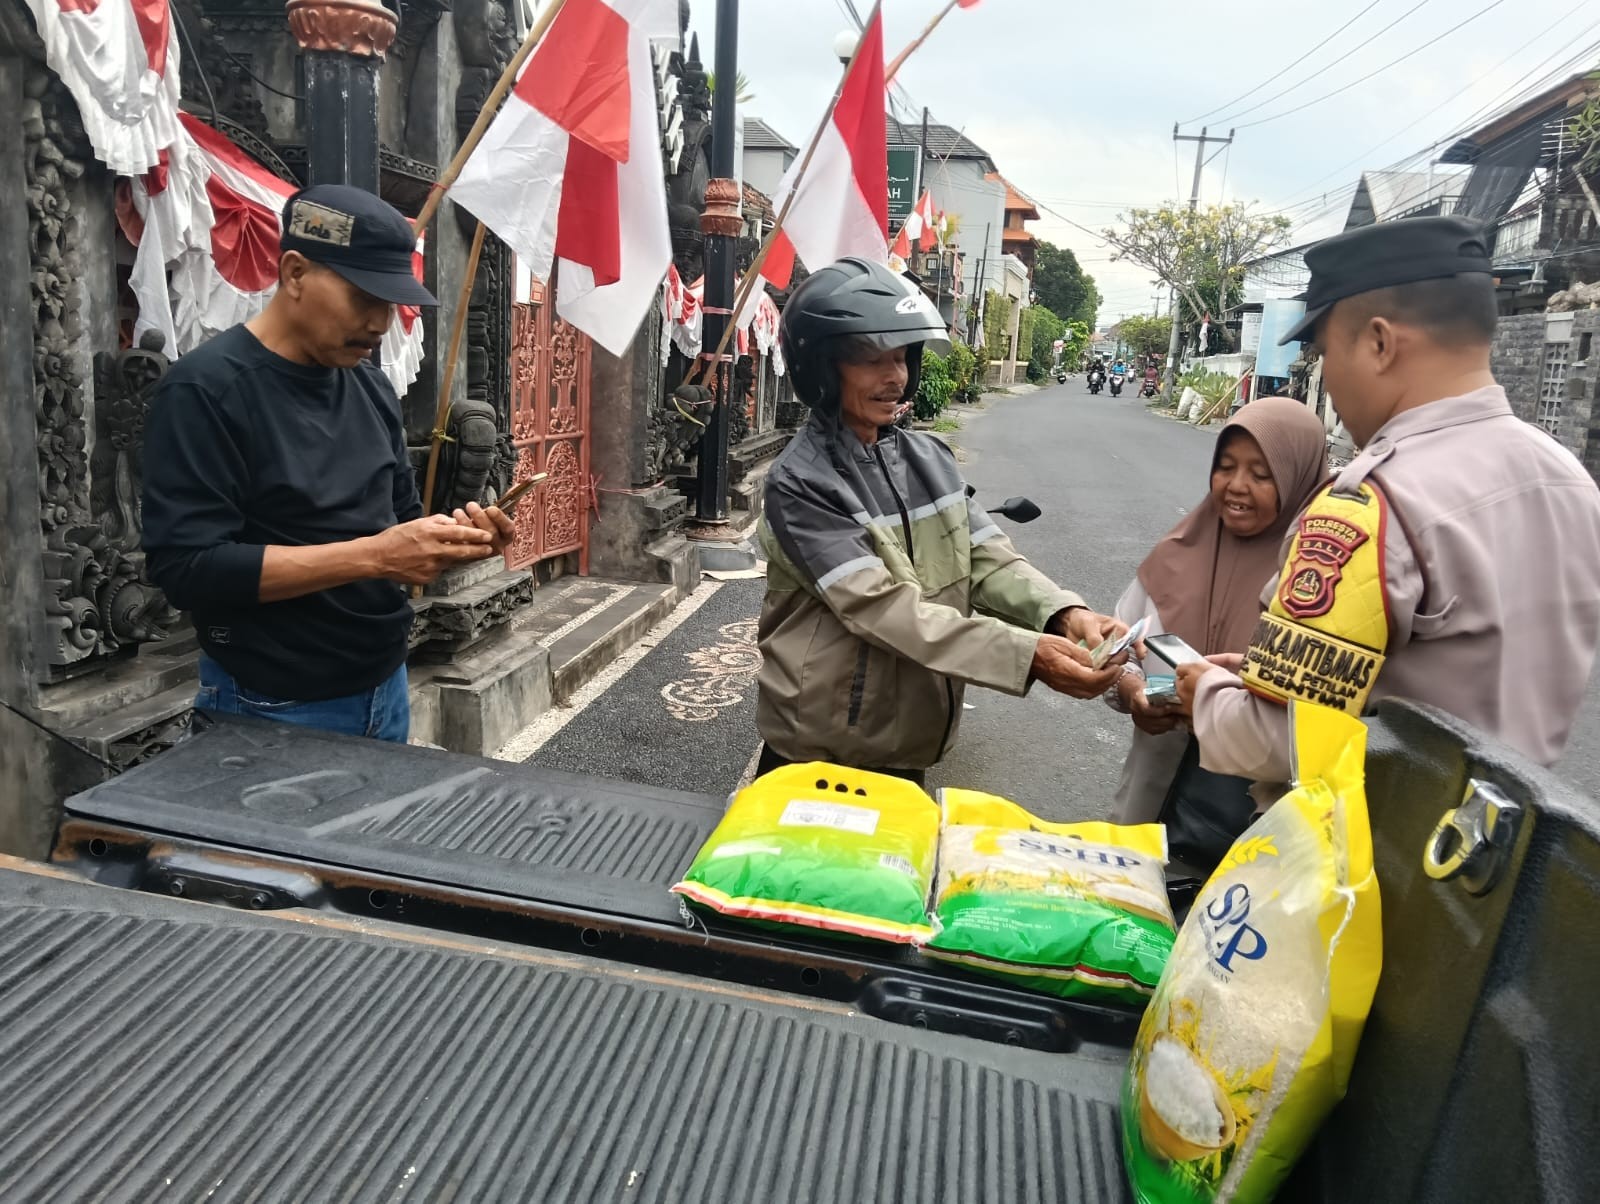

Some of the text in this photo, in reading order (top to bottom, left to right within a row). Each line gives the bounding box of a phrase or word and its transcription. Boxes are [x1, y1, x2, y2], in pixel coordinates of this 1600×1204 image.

[1305, 518, 1358, 539] POLRESTA
[1302, 541, 1343, 557] BALI
[1257, 666, 1347, 710] DENTIM
[1019, 838, 1141, 869] SPHP
